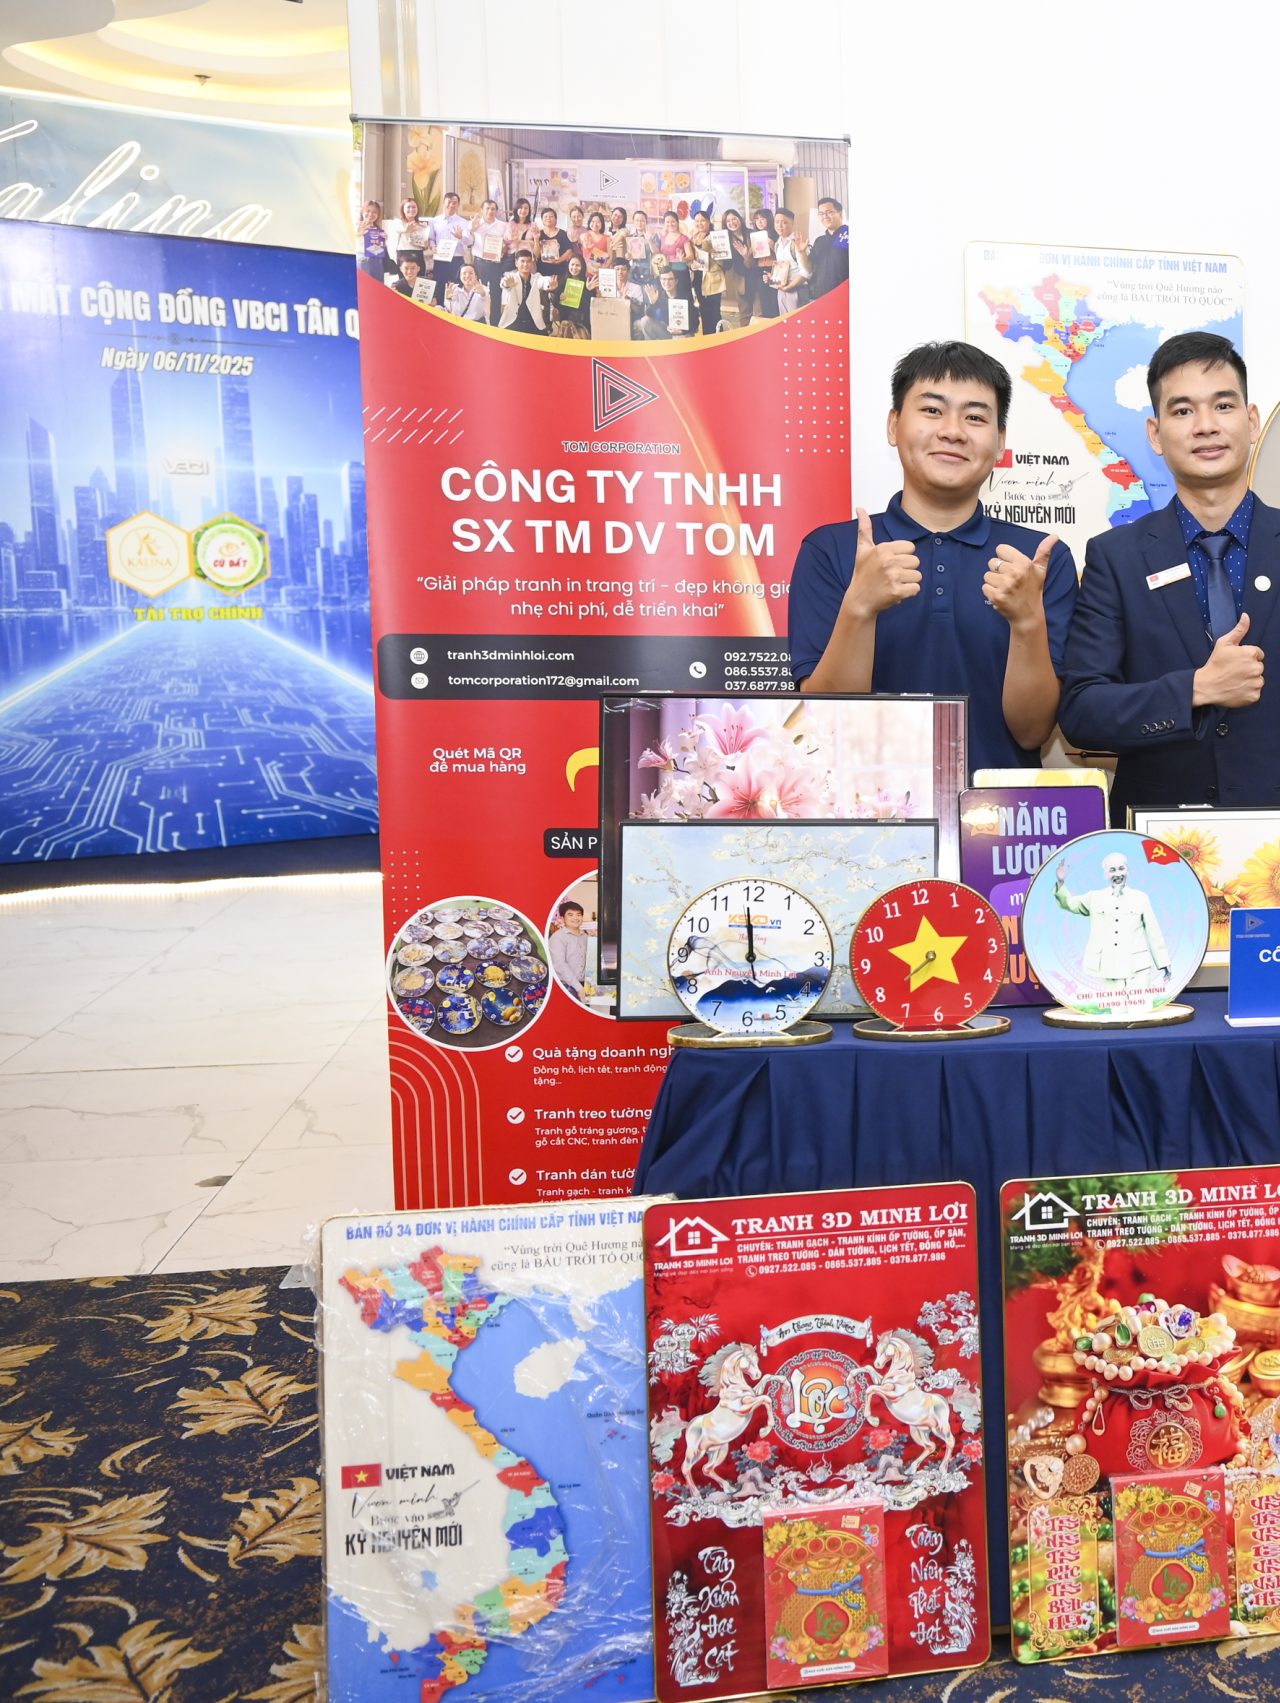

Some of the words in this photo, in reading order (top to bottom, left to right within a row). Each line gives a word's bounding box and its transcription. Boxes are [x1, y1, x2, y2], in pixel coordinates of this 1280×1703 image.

[80, 281, 151, 326] CỘNG
[158, 288, 227, 328] ĐỒNG
[232, 299, 289, 331] VBCI
[293, 298, 340, 337] TÂN
[102, 346, 149, 374] Ngày
[153, 350, 253, 377] 06/11/2025
[562, 440, 588, 453] TOM
[589, 441, 679, 455] CORPORATION
[1015, 452, 1040, 466] VIỆT
[1042, 455, 1069, 465] NAM
[441, 458, 575, 504] CÔNG
[586, 469, 643, 503] TY
[653, 471, 782, 507] TNHH
[1003, 502, 1051, 524] NGUYÊN
[1054, 503, 1075, 523] MỚI
[452, 518, 514, 552] SX
[525, 520, 590, 552] TM
[605, 520, 665, 554] DV
[675, 521, 774, 557] TOM
[417, 575, 456, 590] “Giải
[462, 576, 509, 595] pháp
[514, 577, 561, 591] tranh
[566, 577, 581, 591] in
[586, 579, 632, 596] trang
[638, 578, 655, 592] trí
[675, 579, 707, 597] đẹp
[713, 577, 765, 598] không
[511, 601, 542, 617] nhẹ
[548, 601, 572, 615] chi
[578, 601, 607, 619] phí,
[613, 599, 633, 615] dễ
[639, 601, 676, 616] triển
[683, 603, 724, 616] khai”
[447, 649, 575, 661] tranh3dminhloi.com
[448, 674, 640, 689] tomcorporation172@gmail.com
[724, 679, 796, 692] 037.6877.98
[433, 747, 469, 762] Quét
[473, 747, 495, 763] Mã
[499, 747, 521, 763] QR
[428, 759, 449, 773] để
[451, 762, 486, 773] mua
[489, 759, 526, 774] hàng
[998, 801, 1068, 836] NĂNG
[551, 832, 582, 849] SẢN
[532, 1047, 561, 1059] Quà
[565, 1046, 596, 1060] tặng
[599, 1045, 646, 1058] doanh
[533, 1107, 576, 1120] Tranh
[578, 1108, 607, 1119] treo
[610, 1107, 652, 1120] tường
[535, 1168, 577, 1181] Tranh
[579, 1167, 607, 1180] dán
[1081, 1192, 1157, 1210] TRANH
[1165, 1189, 1193, 1205] 3D
[1200, 1185, 1260, 1203] MINH
[732, 1215, 813, 1234] TRANH
[822, 1211, 851, 1228] 3D
[861, 1207, 921, 1226] MINH
[929, 1202, 968, 1222] LỢI
[737, 1241, 774, 1253] CHUYÊN:
[776, 1239, 804, 1250] TRANH
[806, 1236, 829, 1249] GẠCH
[385, 1464, 417, 1479] VIỆT
[421, 1464, 454, 1476] NAM
